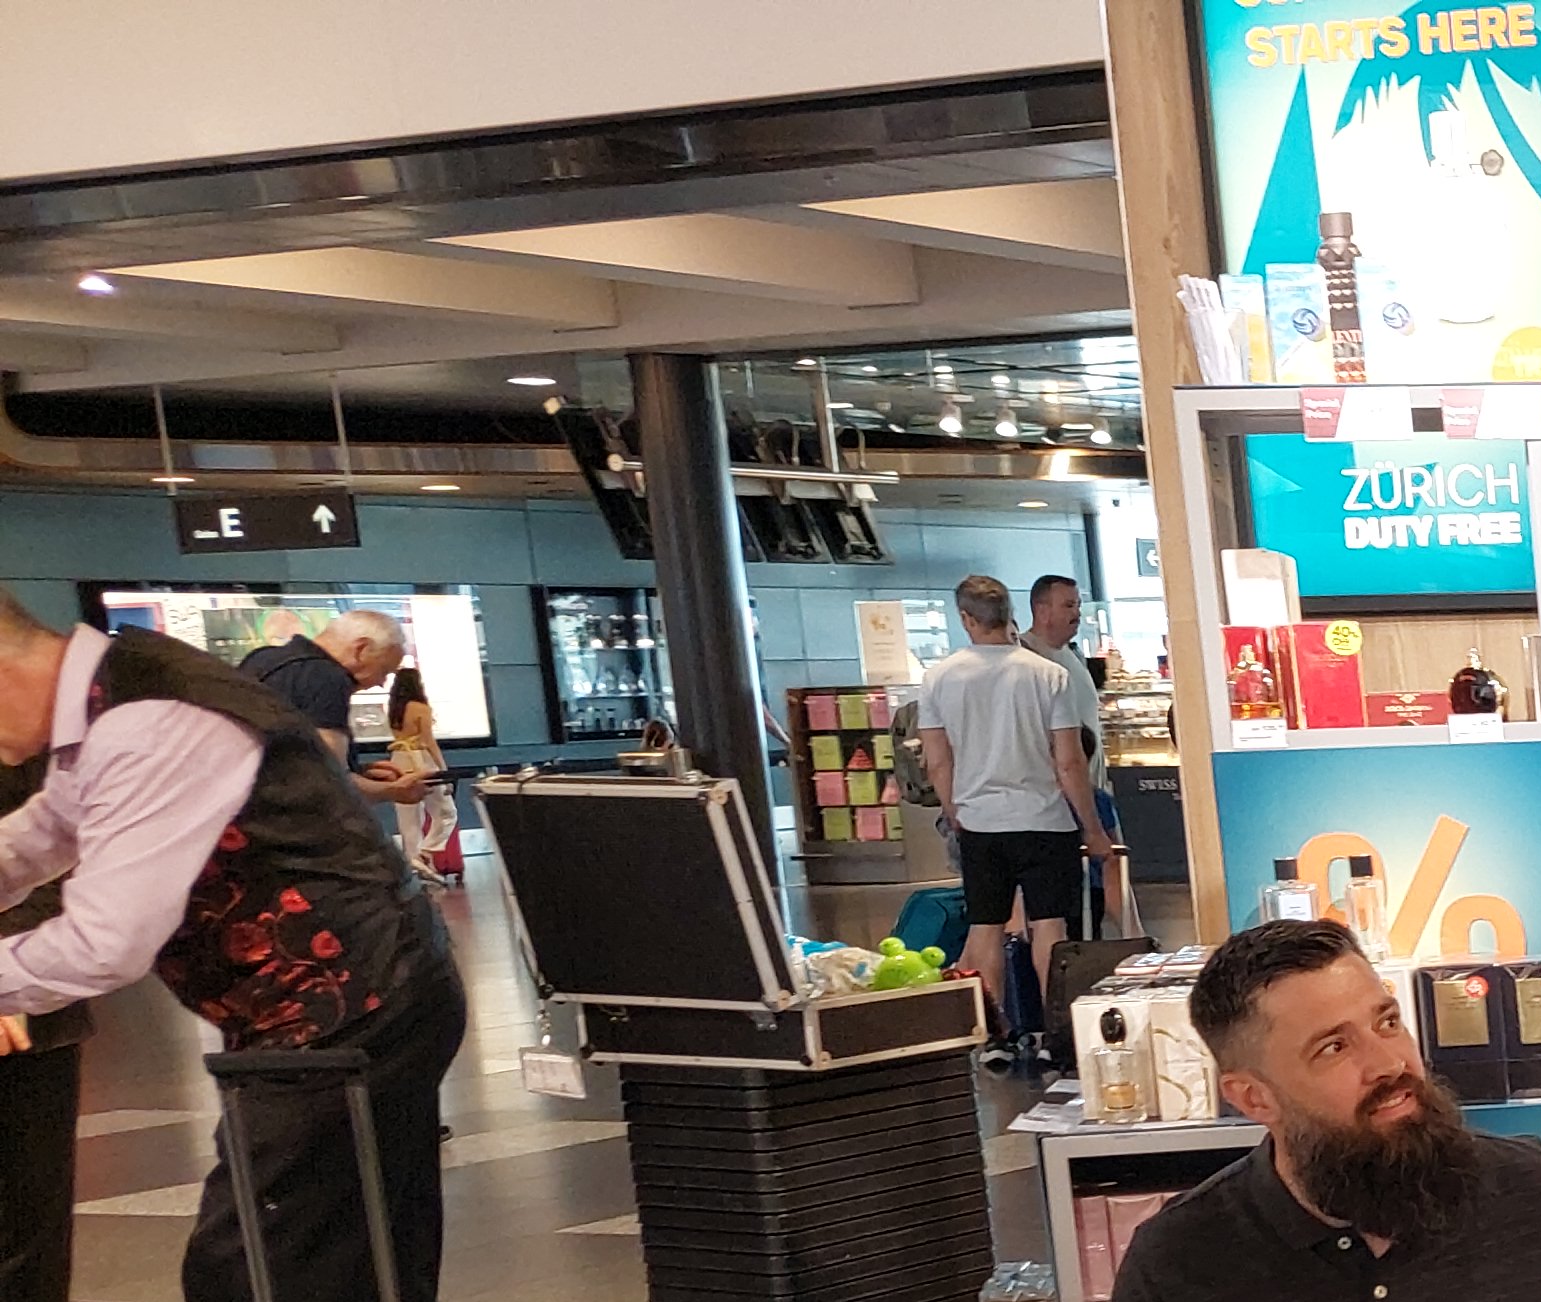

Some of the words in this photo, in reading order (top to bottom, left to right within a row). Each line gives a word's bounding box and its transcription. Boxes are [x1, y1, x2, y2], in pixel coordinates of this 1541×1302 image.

[1245, 16, 1410, 68] STARTS
[1417, 4, 1537, 54] HERE
[1341, 461, 1520, 511] ZÜRICH
[219, 508, 244, 537] E
[1343, 514, 1434, 549] DUTY
[1437, 511, 1522, 545] FREE
